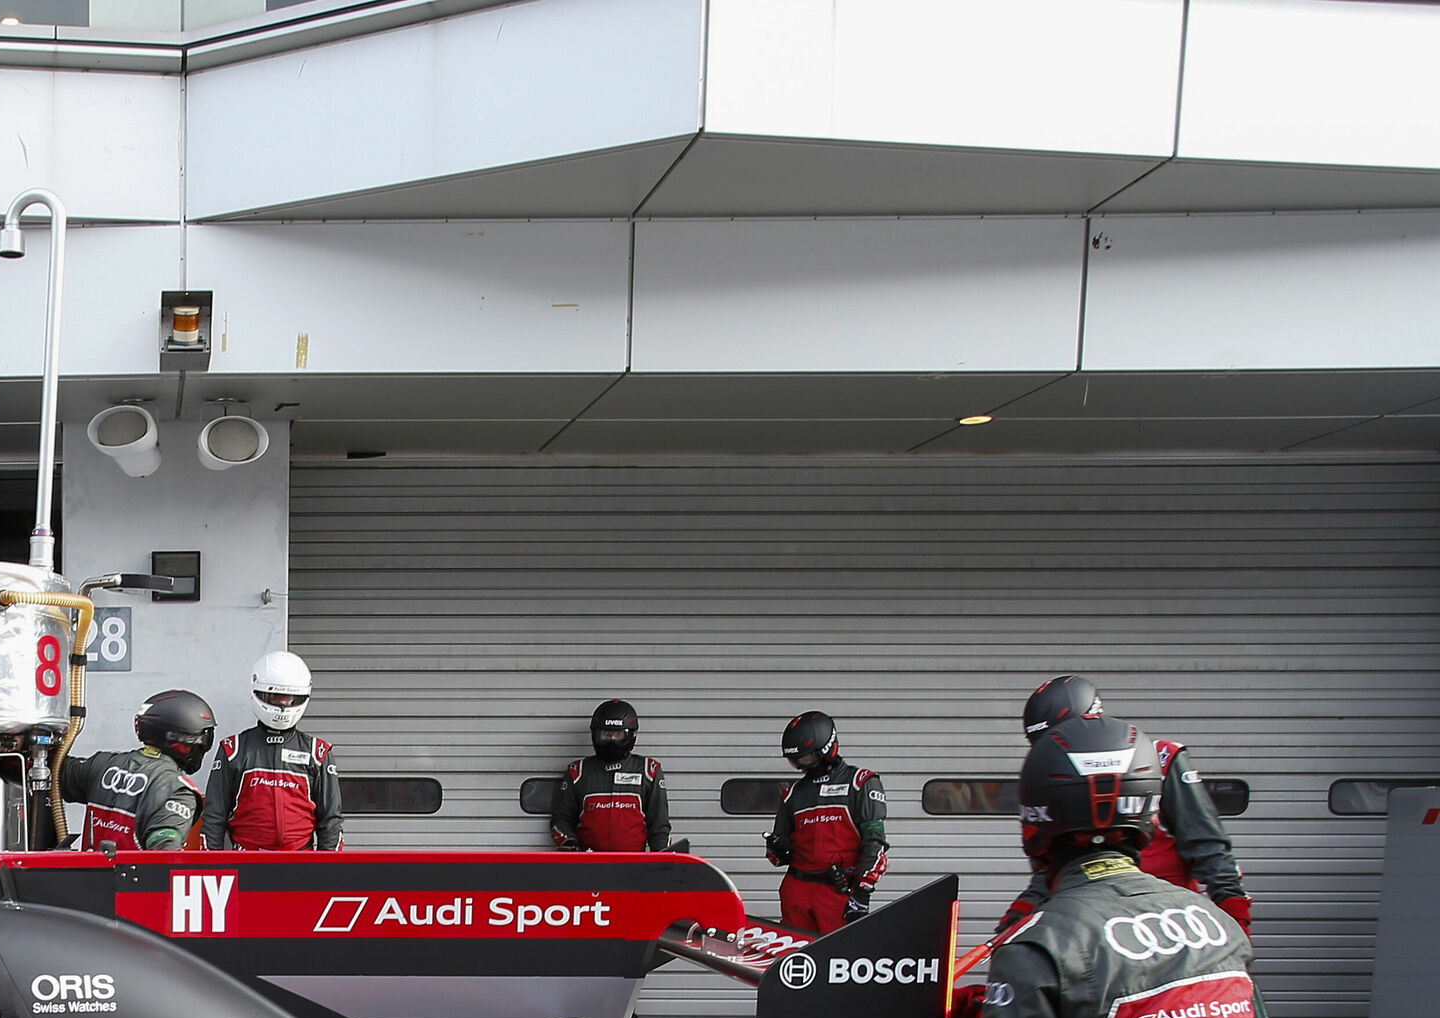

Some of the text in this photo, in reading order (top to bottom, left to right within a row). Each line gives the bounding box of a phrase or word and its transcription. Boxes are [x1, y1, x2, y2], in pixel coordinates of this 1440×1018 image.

[35, 634, 62, 697] 8
[259, 778, 300, 789] Audi Sport
[615, 801, 636, 809] Sport
[172, 874, 235, 933] HY
[374, 897, 611, 934] Audi Sport
[828, 957, 939, 984] BOSCH
[31, 973, 116, 1001] ORIS
[32, 1000, 117, 1014] Swiss Watches
[1210, 998, 1251, 1018] Sport
